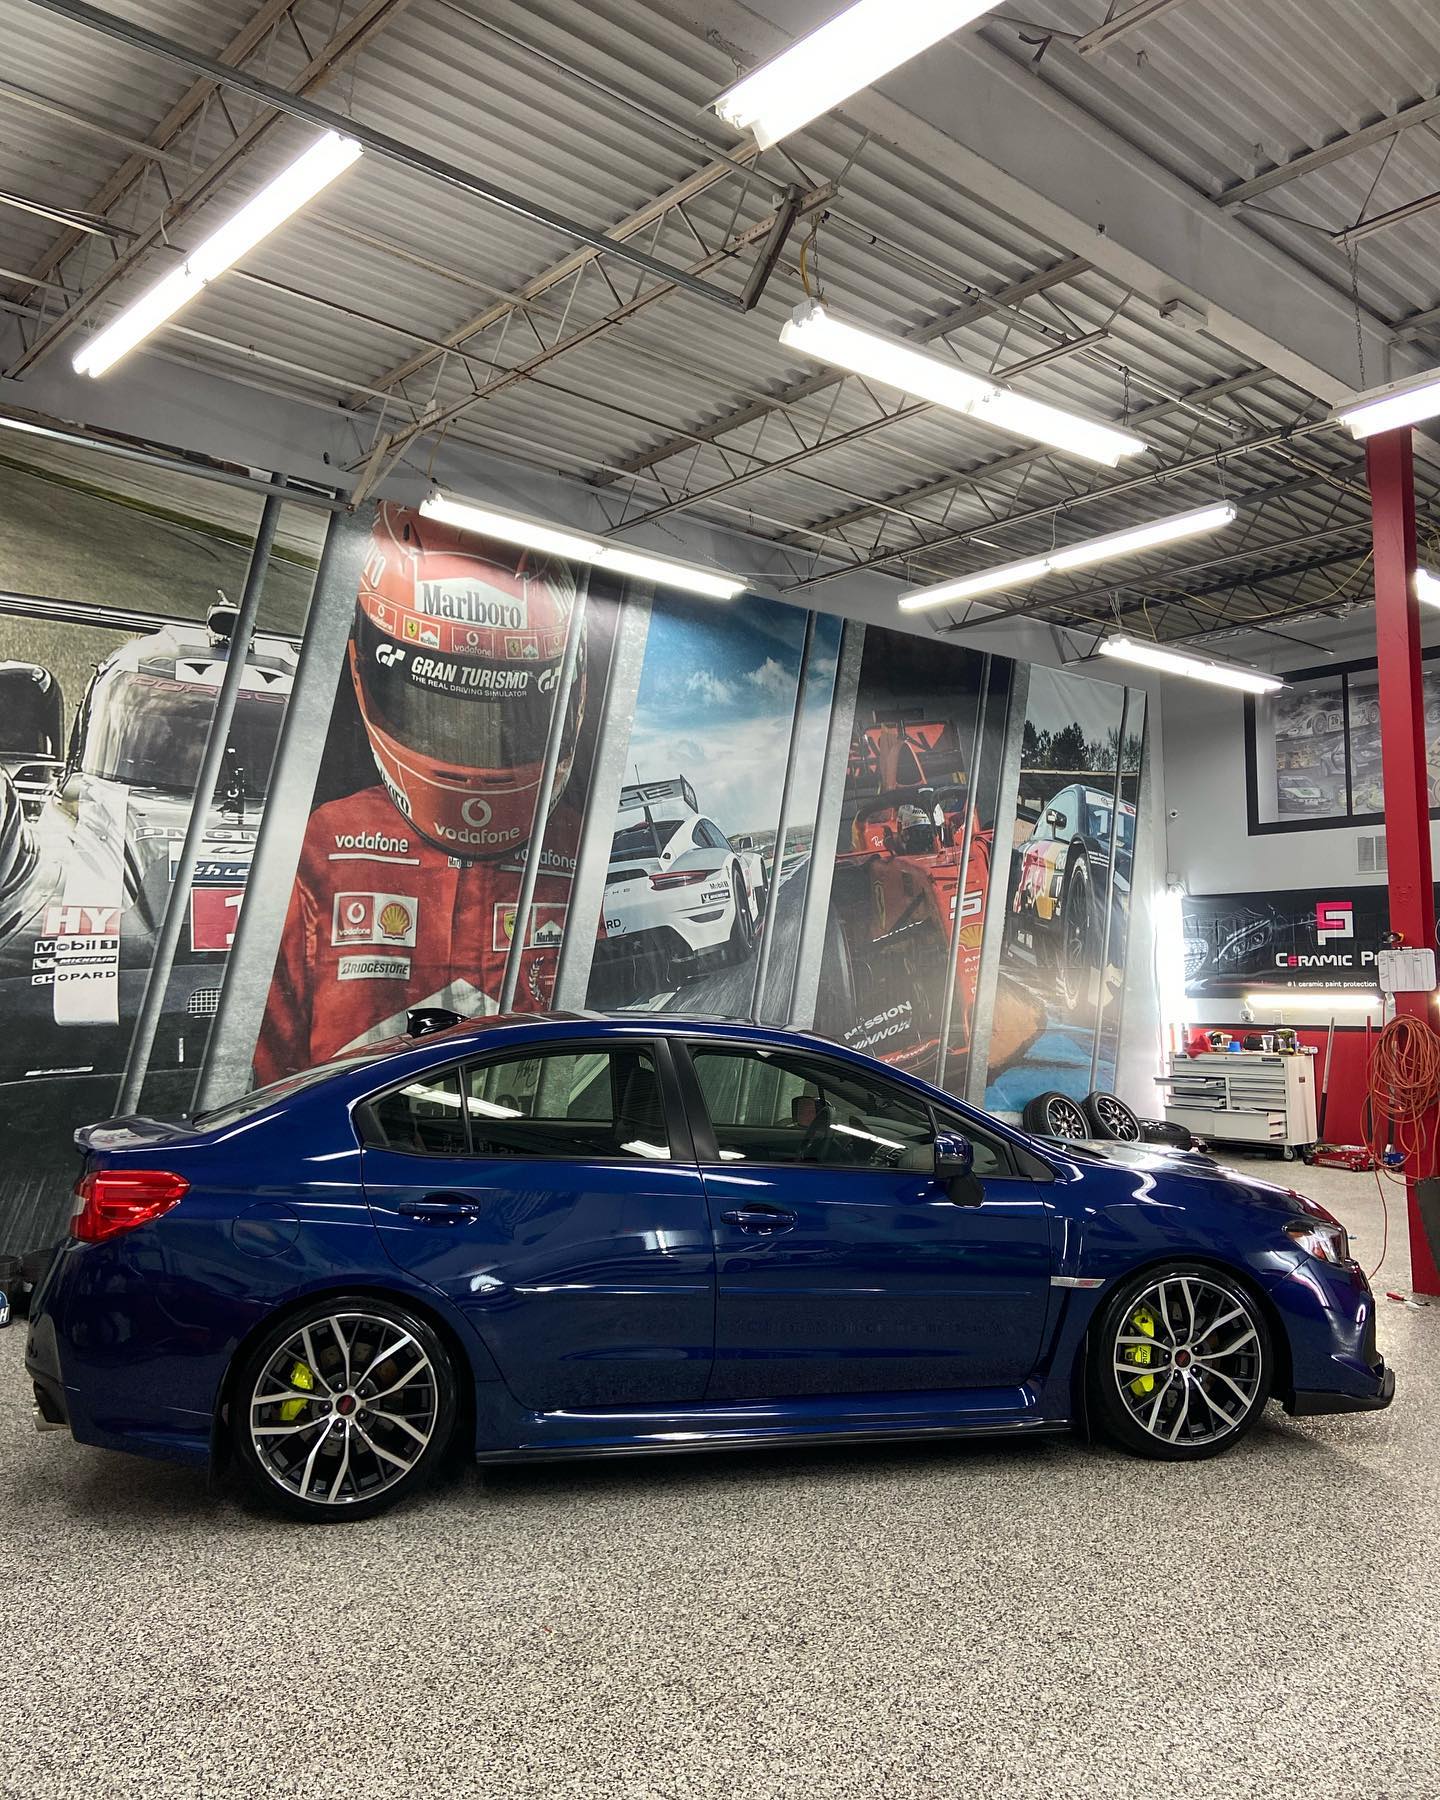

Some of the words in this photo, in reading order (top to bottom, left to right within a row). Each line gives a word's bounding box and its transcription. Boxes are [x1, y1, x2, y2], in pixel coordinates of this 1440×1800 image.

[422, 583, 522, 629] Marlboro
[454, 643, 492, 656] vodafone
[411, 656, 457, 683] GRAN
[460, 666, 528, 689] TURISMO
[411, 674, 426, 685] THE
[428, 678, 448, 690] REAL
[449, 684, 483, 696] DRIVING
[484, 689, 527, 698] SIMULATOR
[433, 822, 521, 844] vodafone
[335, 831, 408, 853] vodafone
[513, 849, 577, 869] voafone
[45, 907, 118, 934] HY
[339, 926, 371, 936] vodafone
[36, 940, 96, 952] Mobil
[59, 956, 116, 965] MICHELIN
[1275, 953, 1353, 967] CERAMIC
[340, 962, 409, 975] BRIDGESTONE
[33, 971, 117, 984] CHOPARD
[1298, 980, 1324, 988] ceramic
[1325, 980, 1343, 988] paint
[1343, 979, 1377, 988] protection
